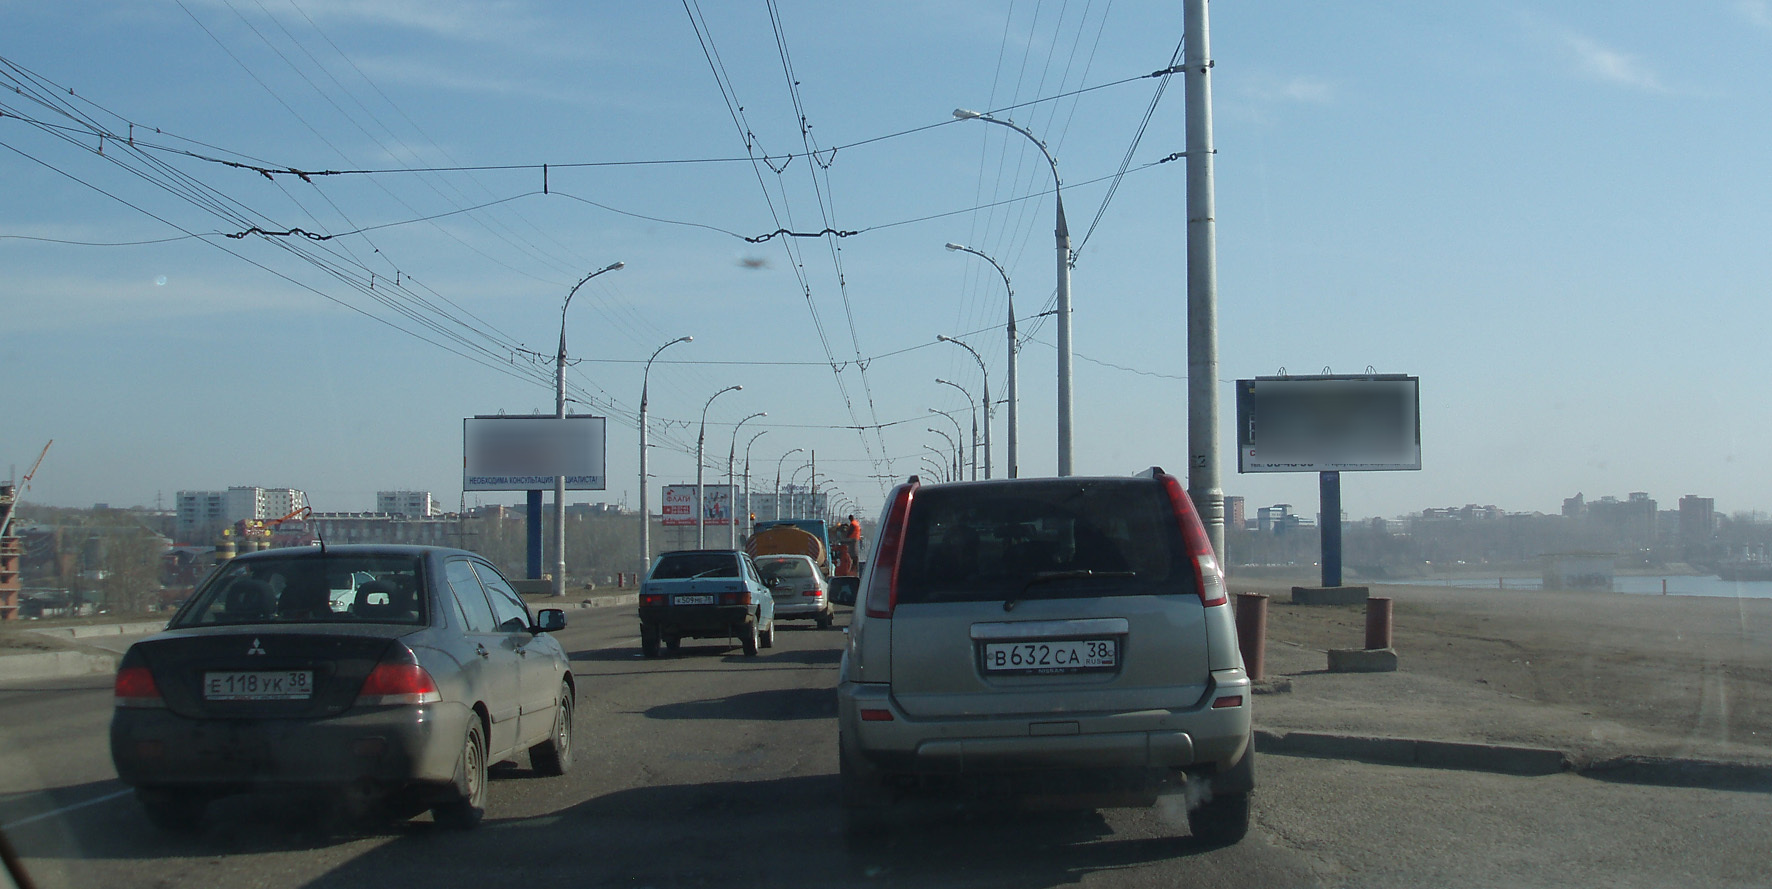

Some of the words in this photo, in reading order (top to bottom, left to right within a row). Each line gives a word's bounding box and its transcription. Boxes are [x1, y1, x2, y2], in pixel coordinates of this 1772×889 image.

[469, 476, 508, 485] НЕОБХОДИМА
[509, 476, 553, 485] КОНСУЛЬТАЦИЯ
[564, 476, 598, 484] ЦИАЛИСТА!
[1087, 642, 1108, 658] 38
[289, 672, 306, 687] 38
